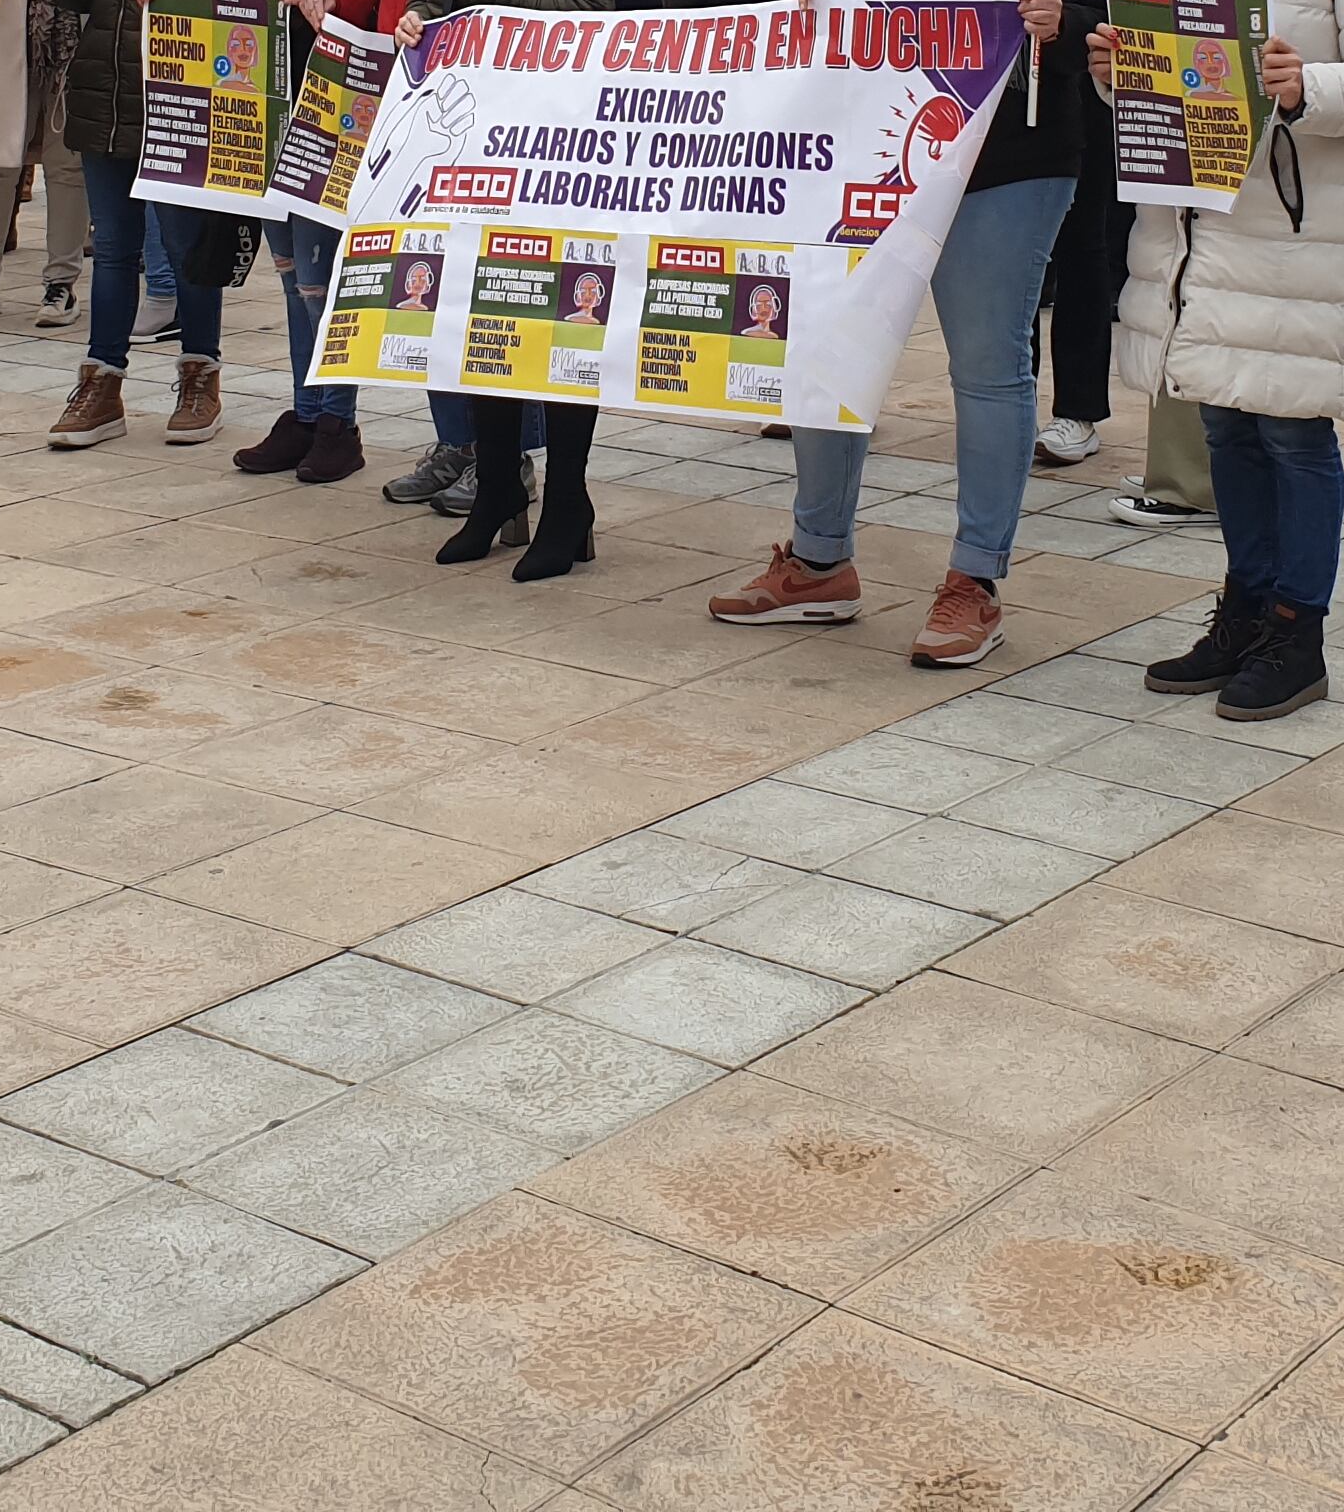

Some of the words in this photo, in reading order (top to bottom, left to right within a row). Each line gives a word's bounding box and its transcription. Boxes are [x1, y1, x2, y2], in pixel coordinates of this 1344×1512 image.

[150, 16, 174, 36] POR
[175, 18, 192, 37] UN
[1250, 13, 1261, 32] 8
[149, 37, 206, 63] CONVENIO
[602, 12, 760, 75] CENTER
[764, 7, 818, 71] EN
[825, 5, 984, 72] LUCHA
[1137, 31, 1155, 50] UN
[149, 60, 185, 82] DIGNO
[1115, 48, 1173, 74] CONVENIO
[1116, 70, 1154, 91] DIGNO
[212, 95, 258, 118] SALARIOS
[301, 87, 336, 116] CONVENIO
[595, 87, 727, 126] EXIGIMOS
[296, 105, 321, 126] DIGNO
[1185, 103, 1240, 122] SALARIOS
[212, 114, 264, 135] TELETRABAJO
[1186, 120, 1248, 137] TELETRABAJO
[211, 129, 263, 151] ESTABILIDAD
[483, 125, 617, 166] SALARIOS
[624, 131, 649, 167] Y
[648, 131, 834, 172] CONDICIONES
[1189, 135, 1249, 152] ESTABILIDAD
[210, 156, 232, 171] SALUD
[1191, 158, 1217, 171] SALUD
[434, 173, 513, 199] CCOO
[517, 168, 674, 213] LABORALES
[680, 175, 787, 216] DIGNAS
[849, 191, 897, 219] CC
[839, 227, 880, 238] servicios
[352, 234, 392, 252] CCOO
[491, 237, 548, 256] CCOO
[661, 248, 721, 268] CCOO
[471, 317, 504, 332] NINGUNA
[504, 320, 516, 332] HA
[469, 332, 509, 349] REALIZADO
[509, 335, 521, 348] SU
[643, 331, 677, 346] NINGUNA
[679, 334, 691, 348] HA
[642, 346, 684, 364] REALIZADO
[685, 349, 697, 363] SU
[465, 361, 513, 377] RETRIBUTIVA
[640, 376, 689, 393] RETRIBUTIVA
